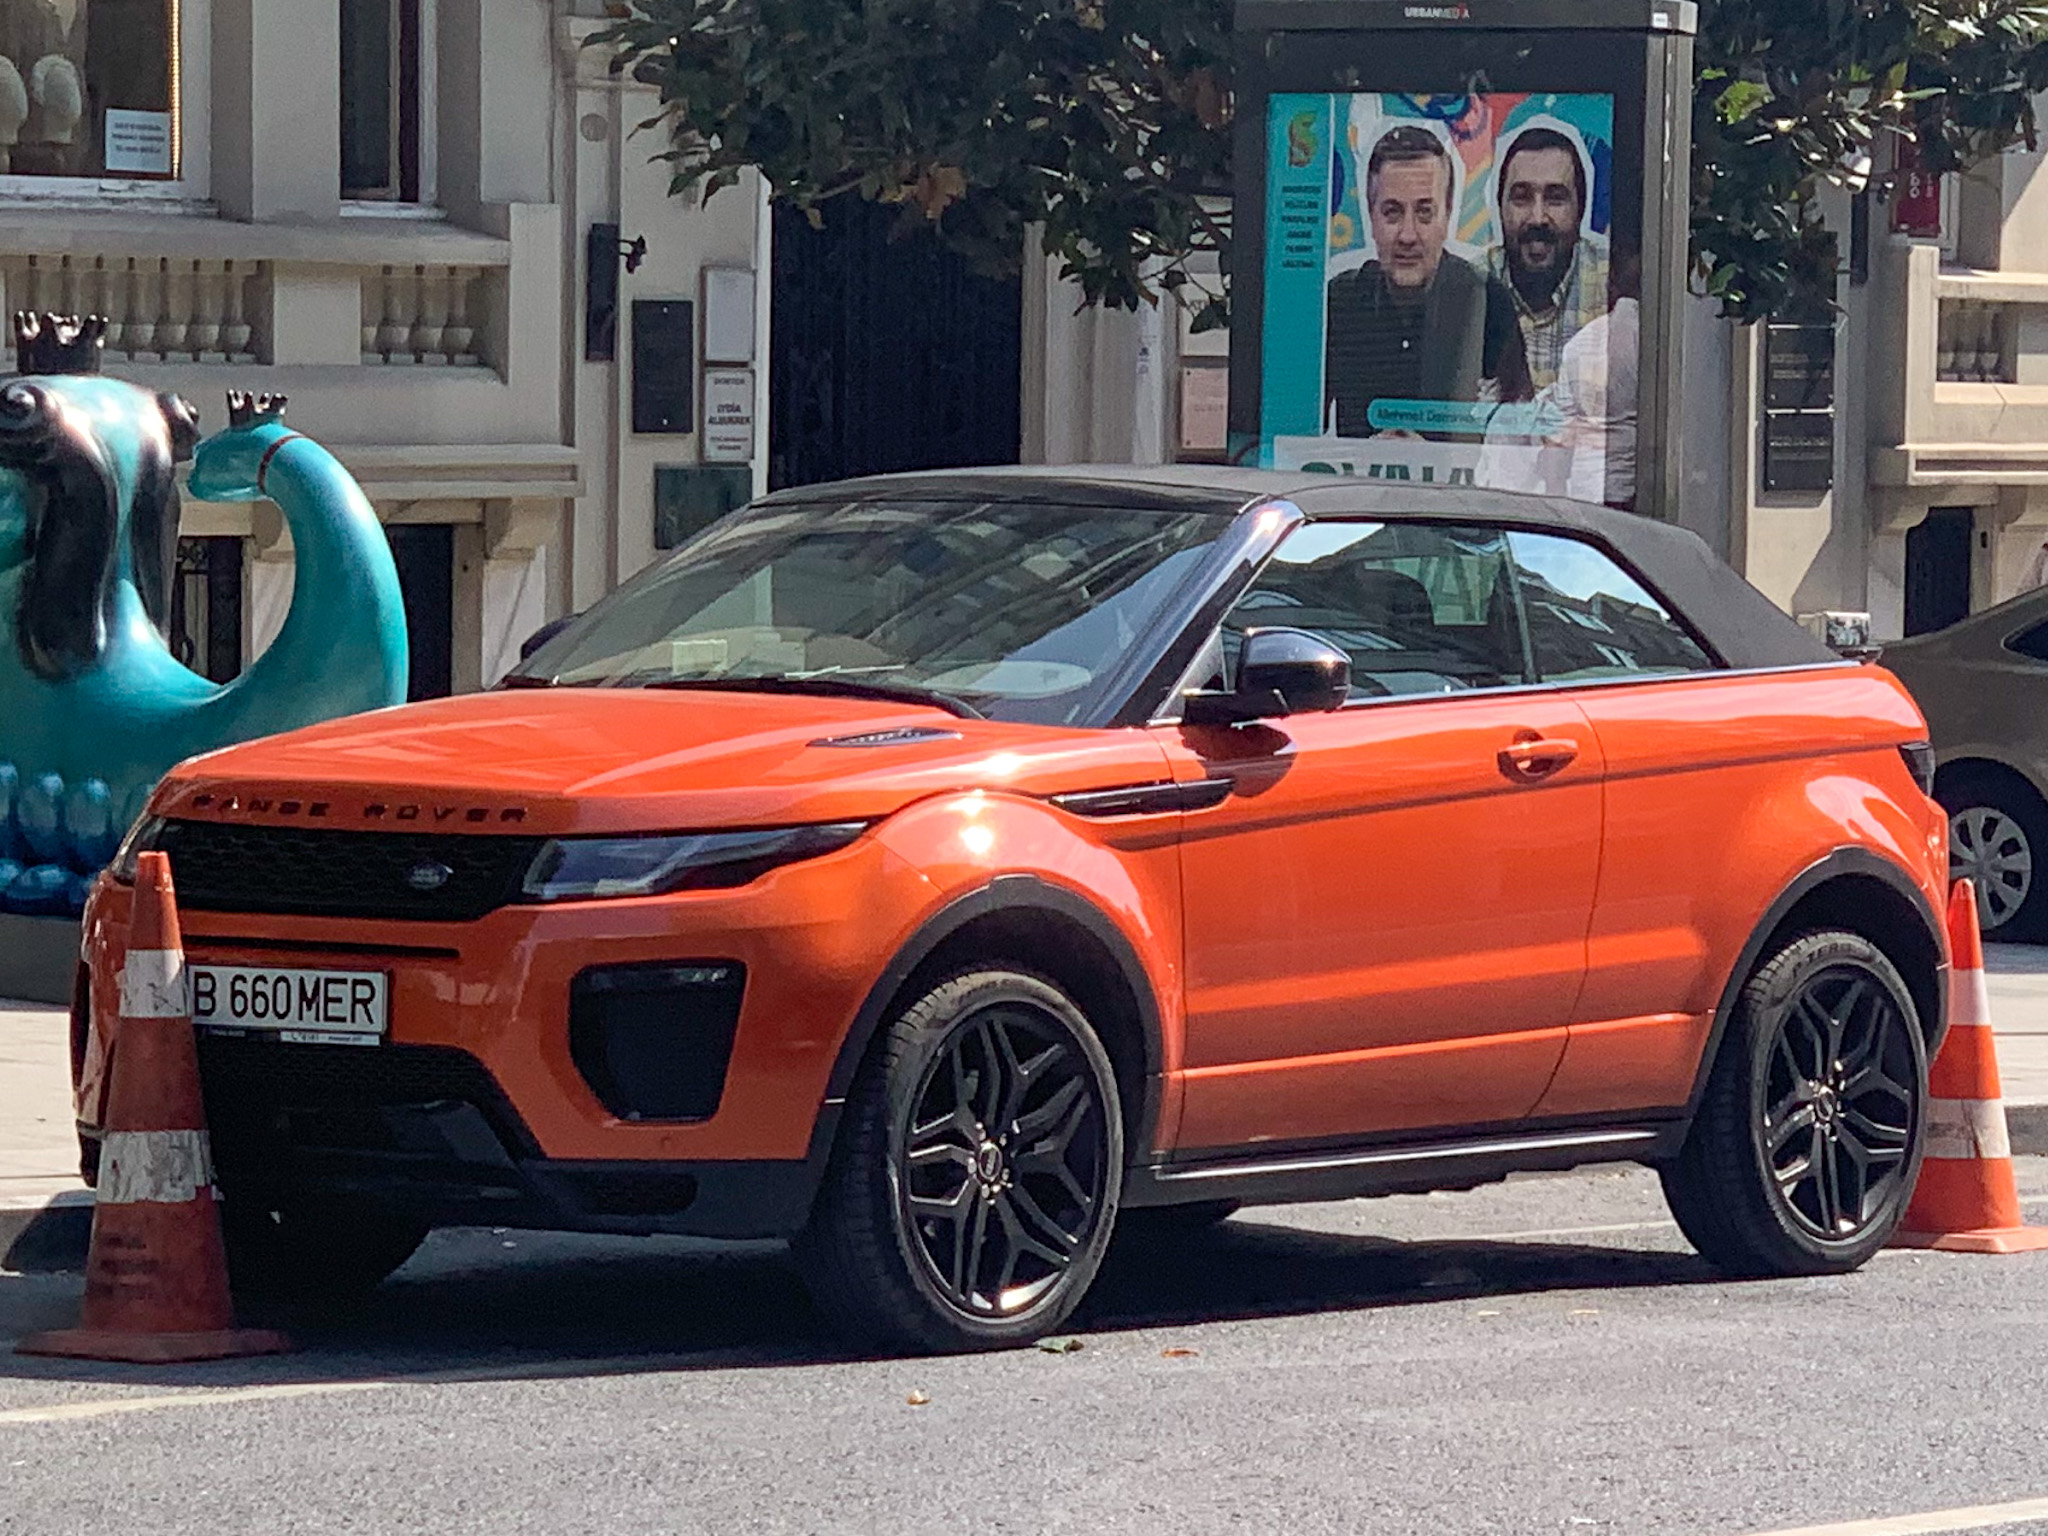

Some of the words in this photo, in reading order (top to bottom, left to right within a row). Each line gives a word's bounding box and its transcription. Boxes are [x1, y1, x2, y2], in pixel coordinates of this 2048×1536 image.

[363, 804, 528, 823] ROVER
[194, 971, 217, 1017] B
[230, 974, 291, 1020] 660
[298, 975, 377, 1025] MER
